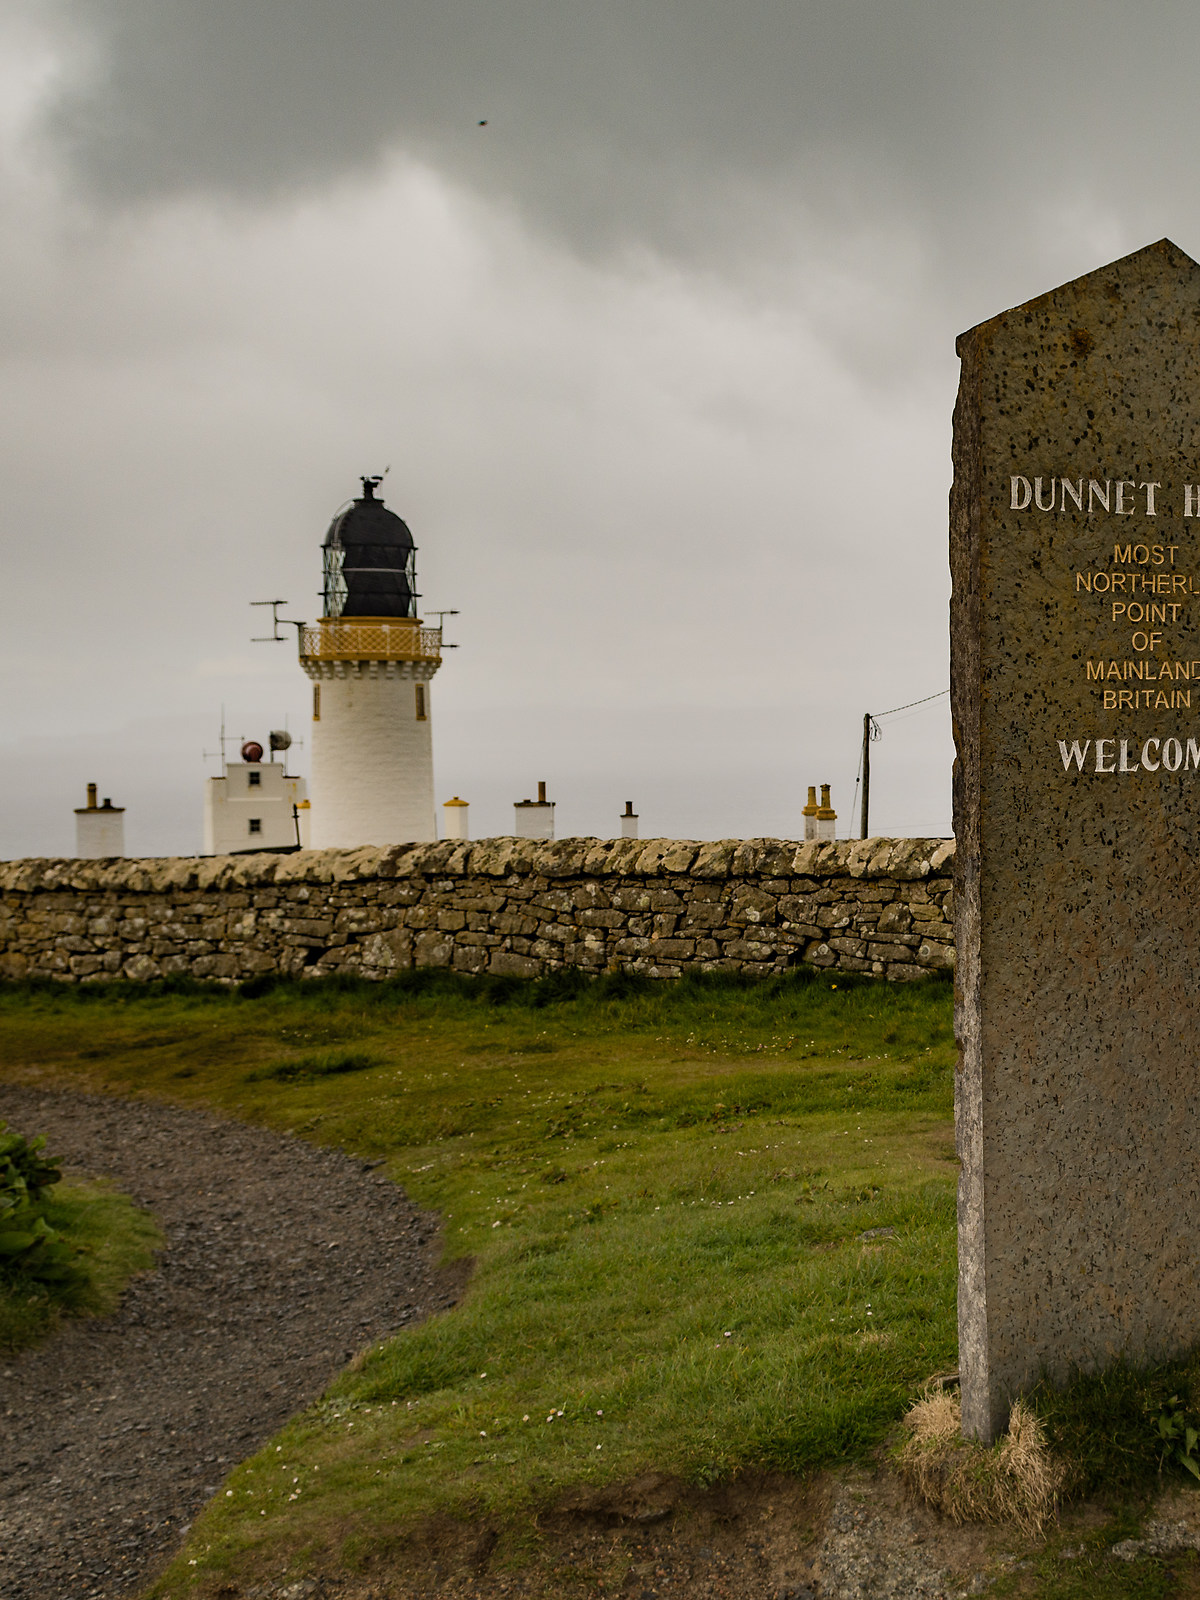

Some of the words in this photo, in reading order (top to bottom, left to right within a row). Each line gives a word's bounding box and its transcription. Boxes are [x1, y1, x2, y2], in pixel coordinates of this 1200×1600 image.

[1010, 475, 1162, 516] DUNNET
[1114, 544, 1179, 565] MOST
[1112, 602, 1182, 622] POINT
[1131, 631, 1163, 652] OF
[1103, 689, 1192, 710] BRITAIN
